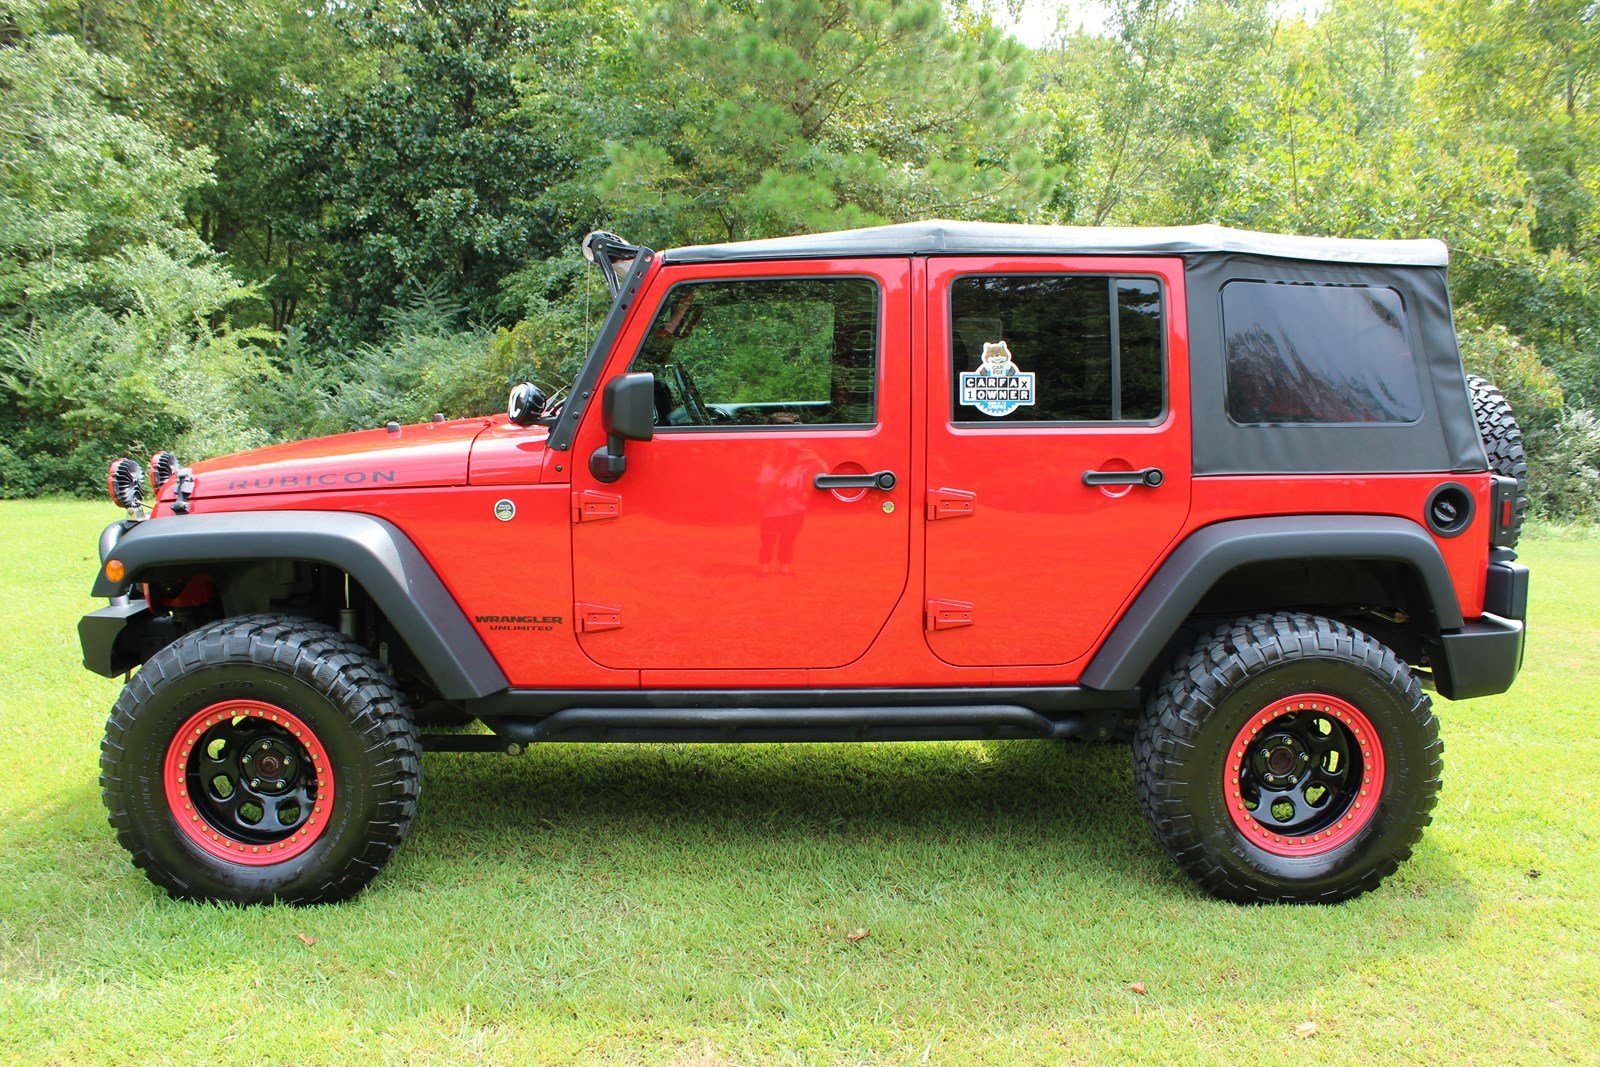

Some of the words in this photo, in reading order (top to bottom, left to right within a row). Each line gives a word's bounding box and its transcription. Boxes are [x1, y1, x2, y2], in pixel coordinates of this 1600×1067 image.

[966, 378, 1028, 388] CARFAX
[968, 391, 973, 399] 1
[977, 390, 1029, 399] OWNER
[228, 470, 395, 490] RUBICON
[475, 615, 563, 624] WRANGLER
